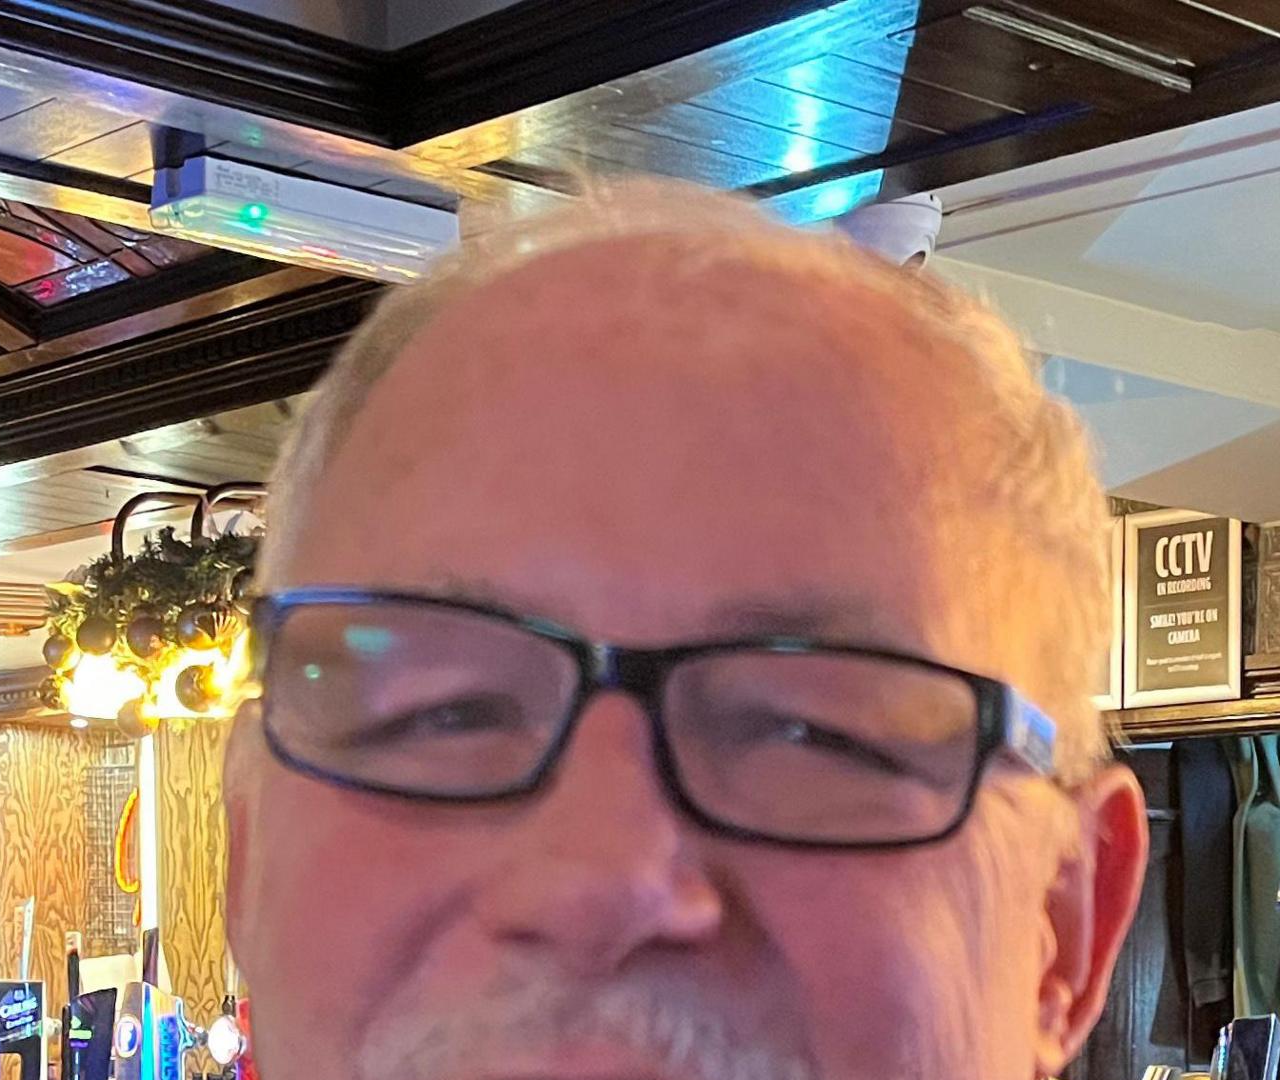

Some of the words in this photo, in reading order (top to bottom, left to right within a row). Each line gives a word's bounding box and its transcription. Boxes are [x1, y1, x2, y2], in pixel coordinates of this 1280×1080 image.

[1155, 530, 1214, 578] CCTV
[1176, 609, 1205, 627] YOU'RE
[1205, 608, 1218, 623] ON
[1167, 628, 1200, 645] CAMERA
